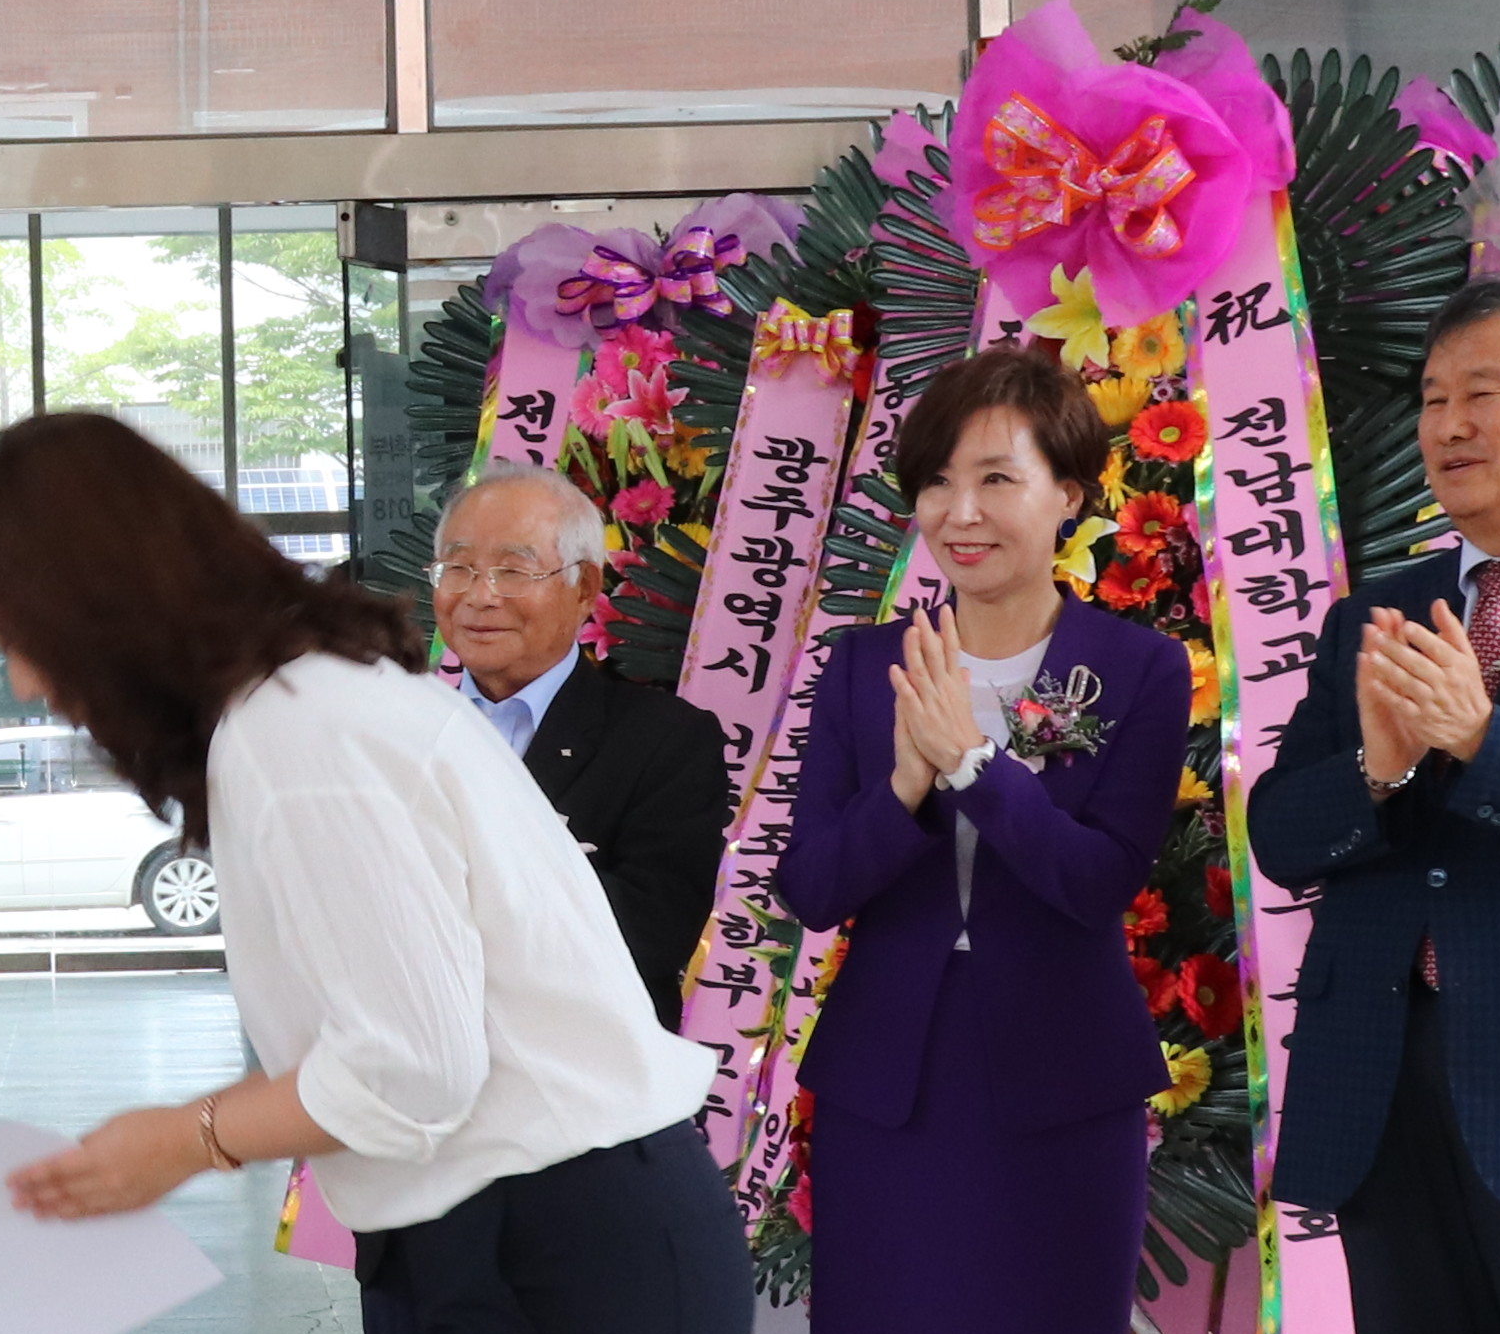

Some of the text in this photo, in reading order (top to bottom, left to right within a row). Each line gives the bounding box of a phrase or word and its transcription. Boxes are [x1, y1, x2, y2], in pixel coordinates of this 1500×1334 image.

[701, 435, 831, 695] 광주광역시
[1204, 281, 1332, 684] 祝 전남대학교
